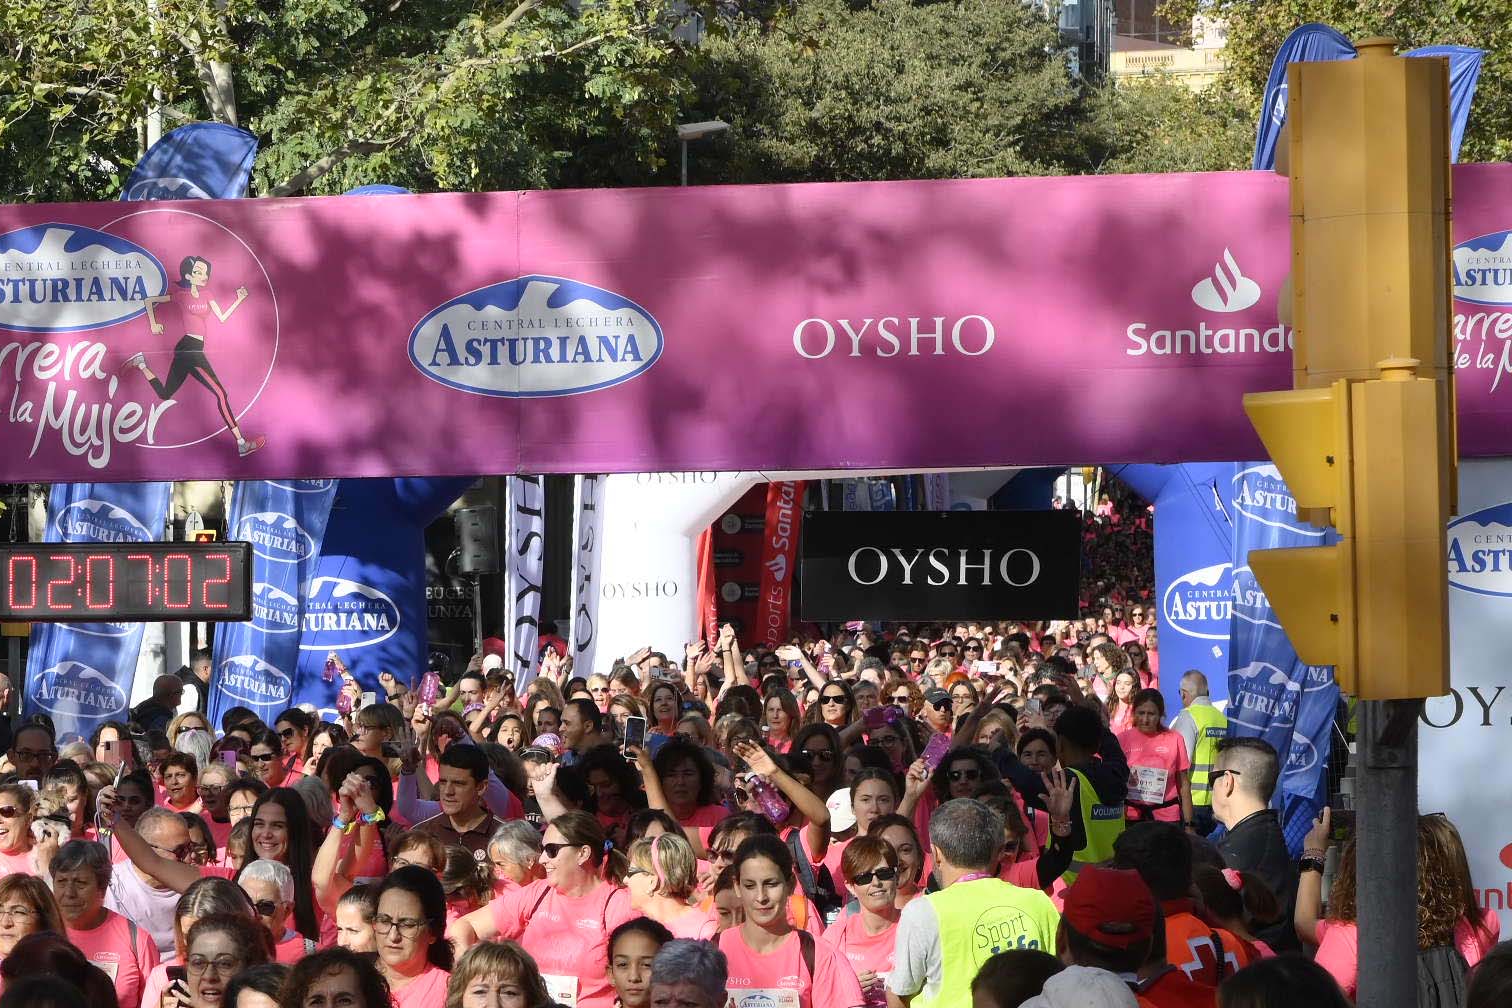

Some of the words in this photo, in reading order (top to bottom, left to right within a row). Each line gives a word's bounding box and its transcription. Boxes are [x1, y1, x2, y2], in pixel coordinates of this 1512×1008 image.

[70, 258, 143, 271] LECHERA
[1466, 256, 1512, 266] CENTRA
[466, 317, 546, 332] CENTRAL
[553, 315, 635, 329] LECHERA
[792, 313, 996, 361] OYSHO
[1125, 320, 1295, 357] Santand
[427, 322, 644, 367] ASTURIANA
[8, 383, 34, 424] la
[28, 374, 178, 470] Mujer
[1238, 480, 1297, 515] ASTUR
[1256, 480, 1289, 492] CENTR
[1474, 534, 1512, 545] CENT
[8, 552, 233, 610] 02:07:02
[847, 546, 1041, 588] OYSHO
[309, 601, 333, 610] TRAL
[601, 579, 679, 600] OYSHO
[1187, 590, 1231, 599] CENTRA
[1418, 686, 1512, 729] OY
[975, 912, 1028, 950] Sport
